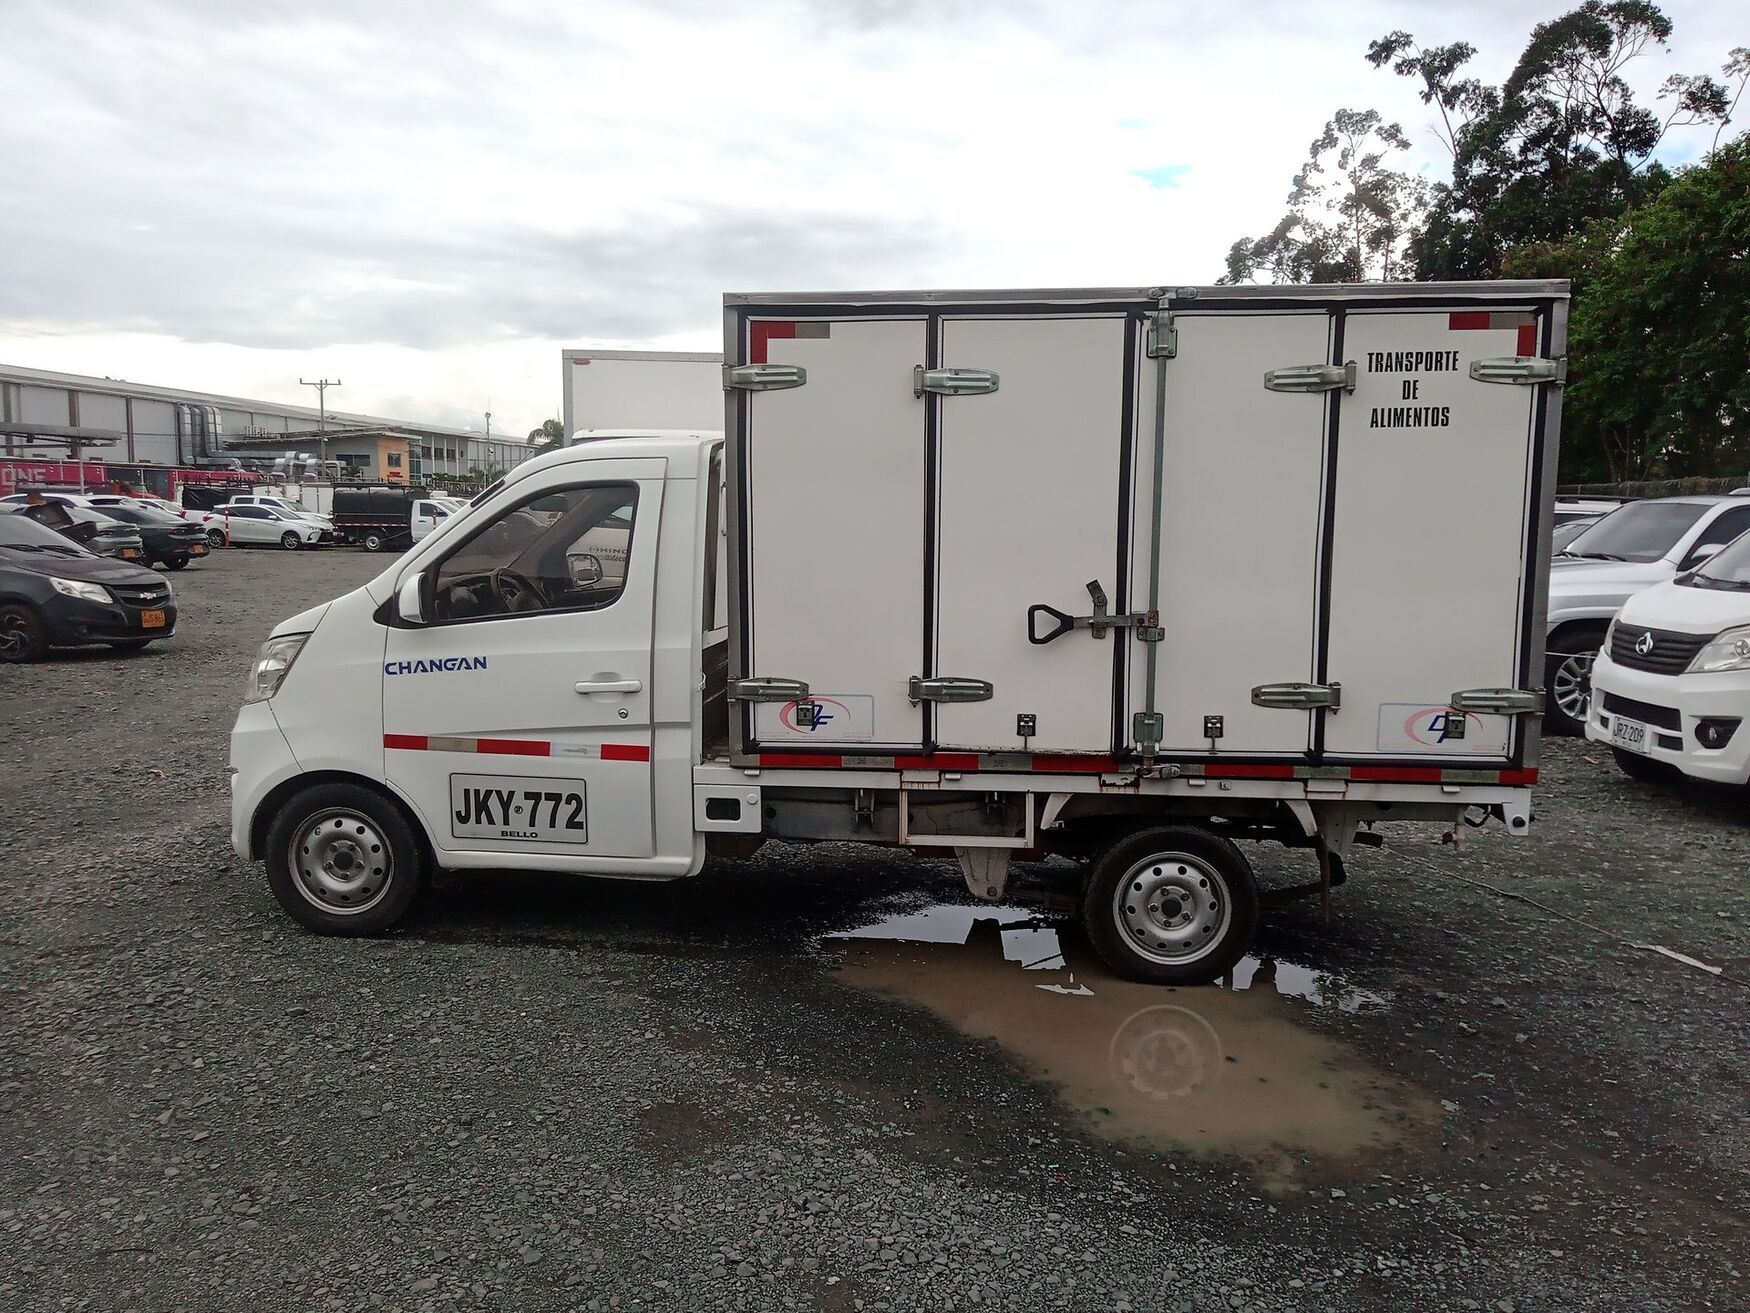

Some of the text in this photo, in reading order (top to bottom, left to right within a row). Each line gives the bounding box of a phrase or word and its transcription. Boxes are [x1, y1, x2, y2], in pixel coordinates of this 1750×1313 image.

[1367, 350, 1459, 373] TRANSPORTE
[1402, 379, 1419, 400] DE
[1369, 406, 1450, 428] ALIMENTOS
[384, 656, 487, 675] CHANGAN
[500, 830, 539, 839] BELLO
